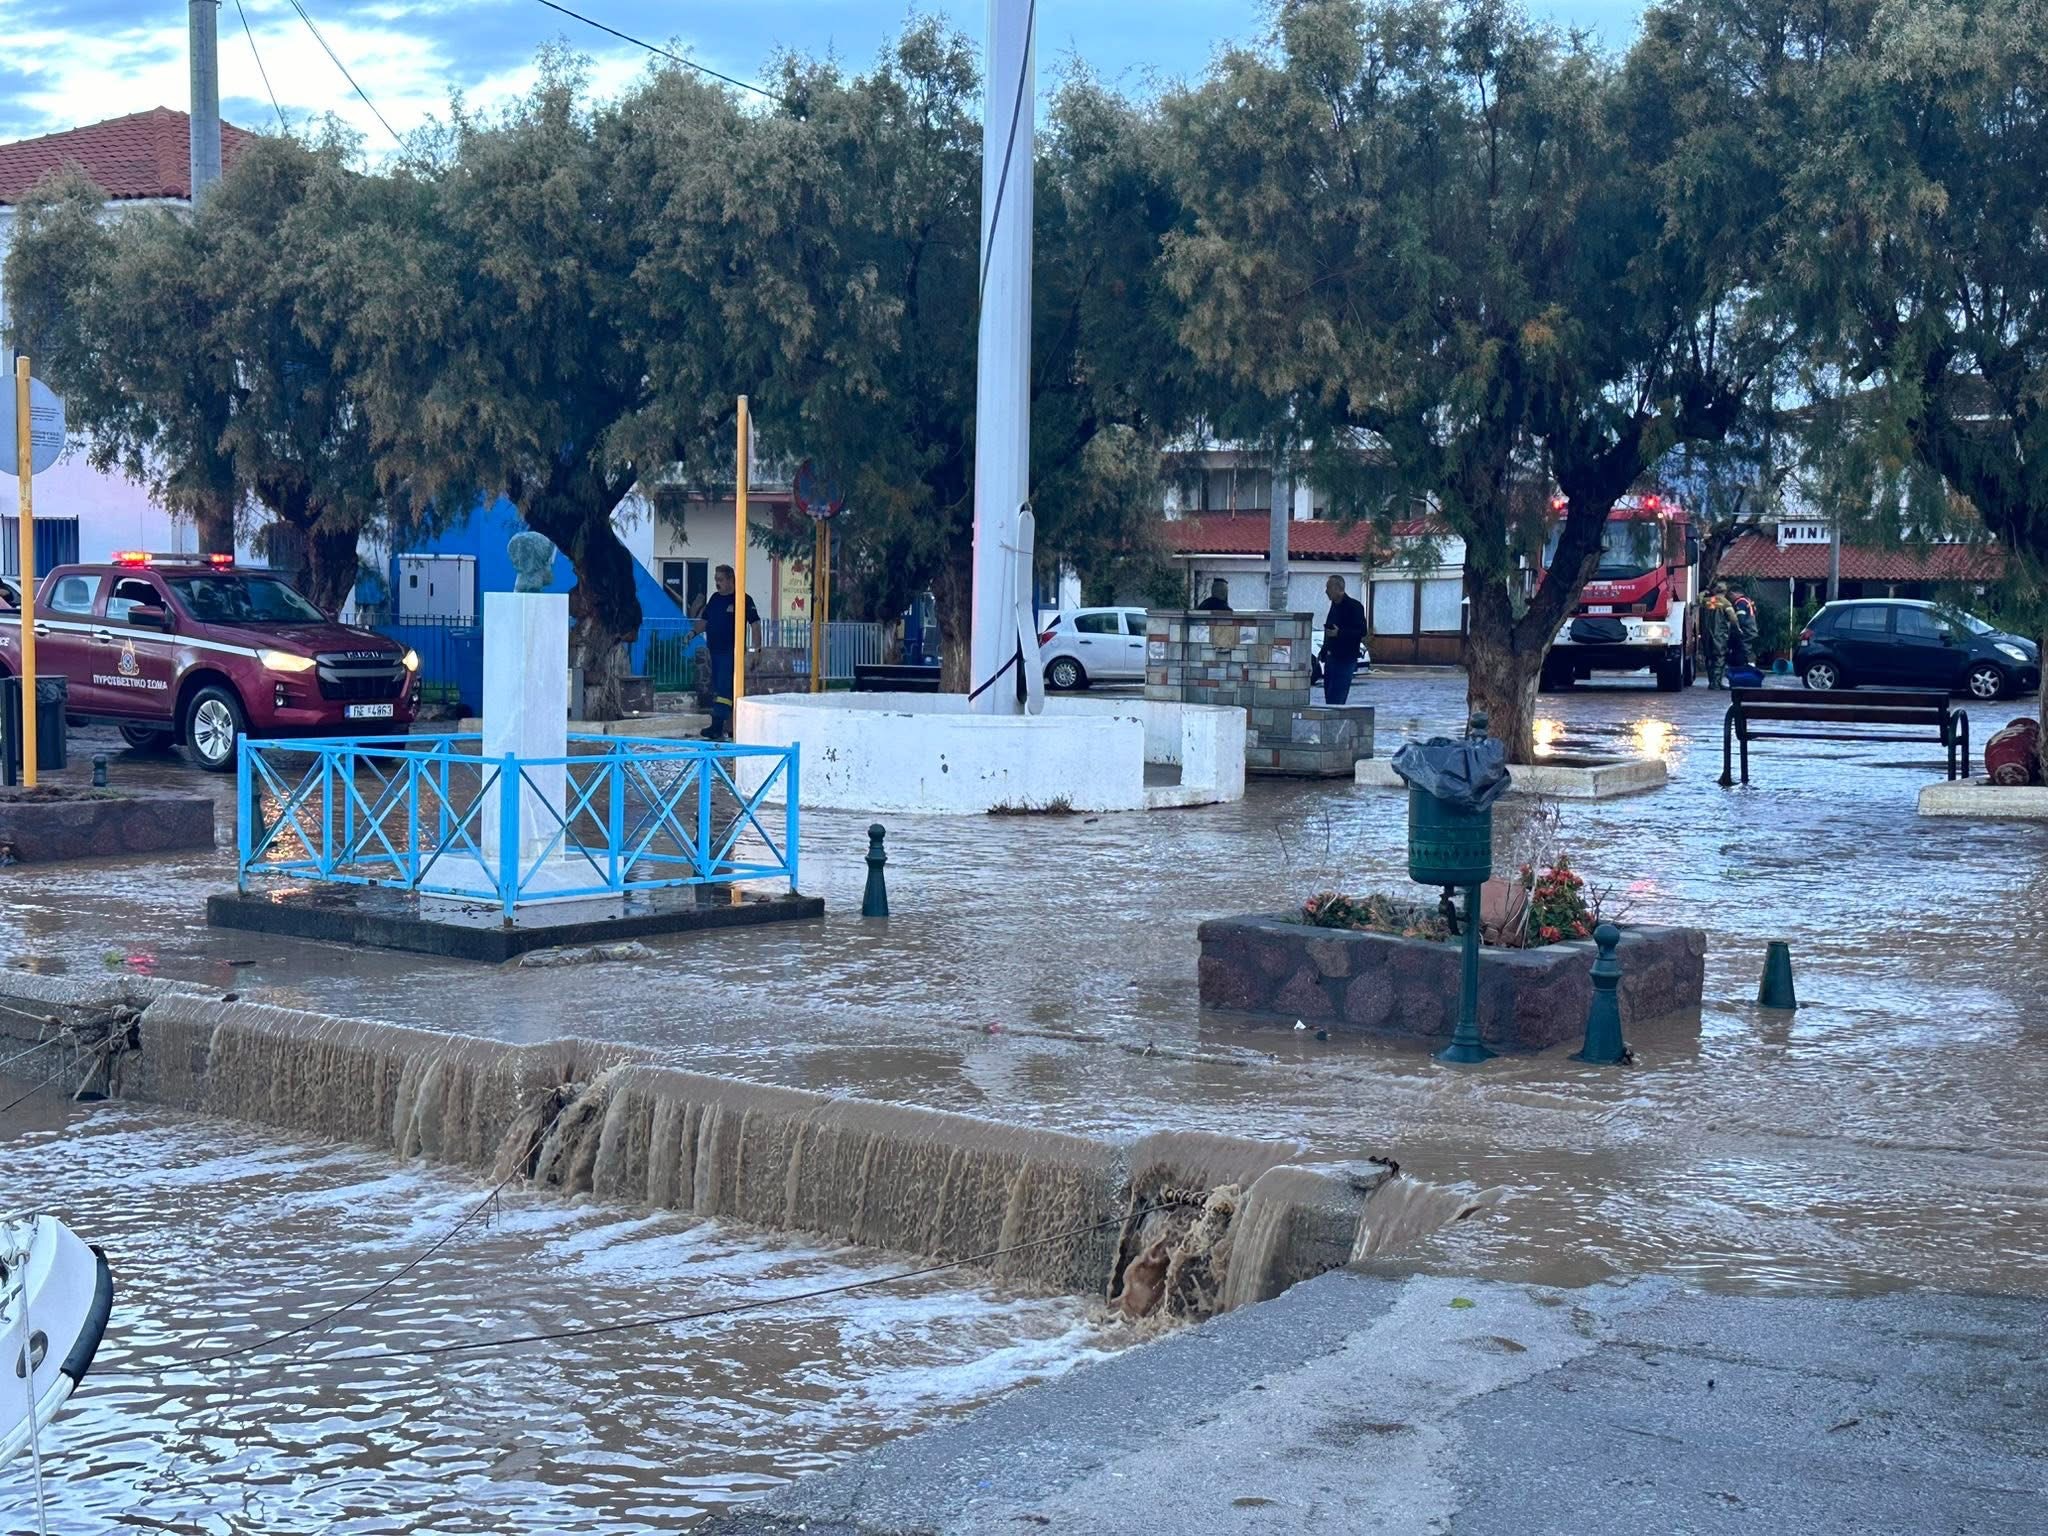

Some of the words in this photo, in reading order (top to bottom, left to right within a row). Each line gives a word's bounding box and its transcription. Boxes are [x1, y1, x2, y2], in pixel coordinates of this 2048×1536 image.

[1784, 527, 1825, 539] MINI
[93, 674, 146, 688] ΠΥΡΟΣΒΕΣΤΙΚΟ
[147, 679, 168, 690] ΣΩΜΑ
